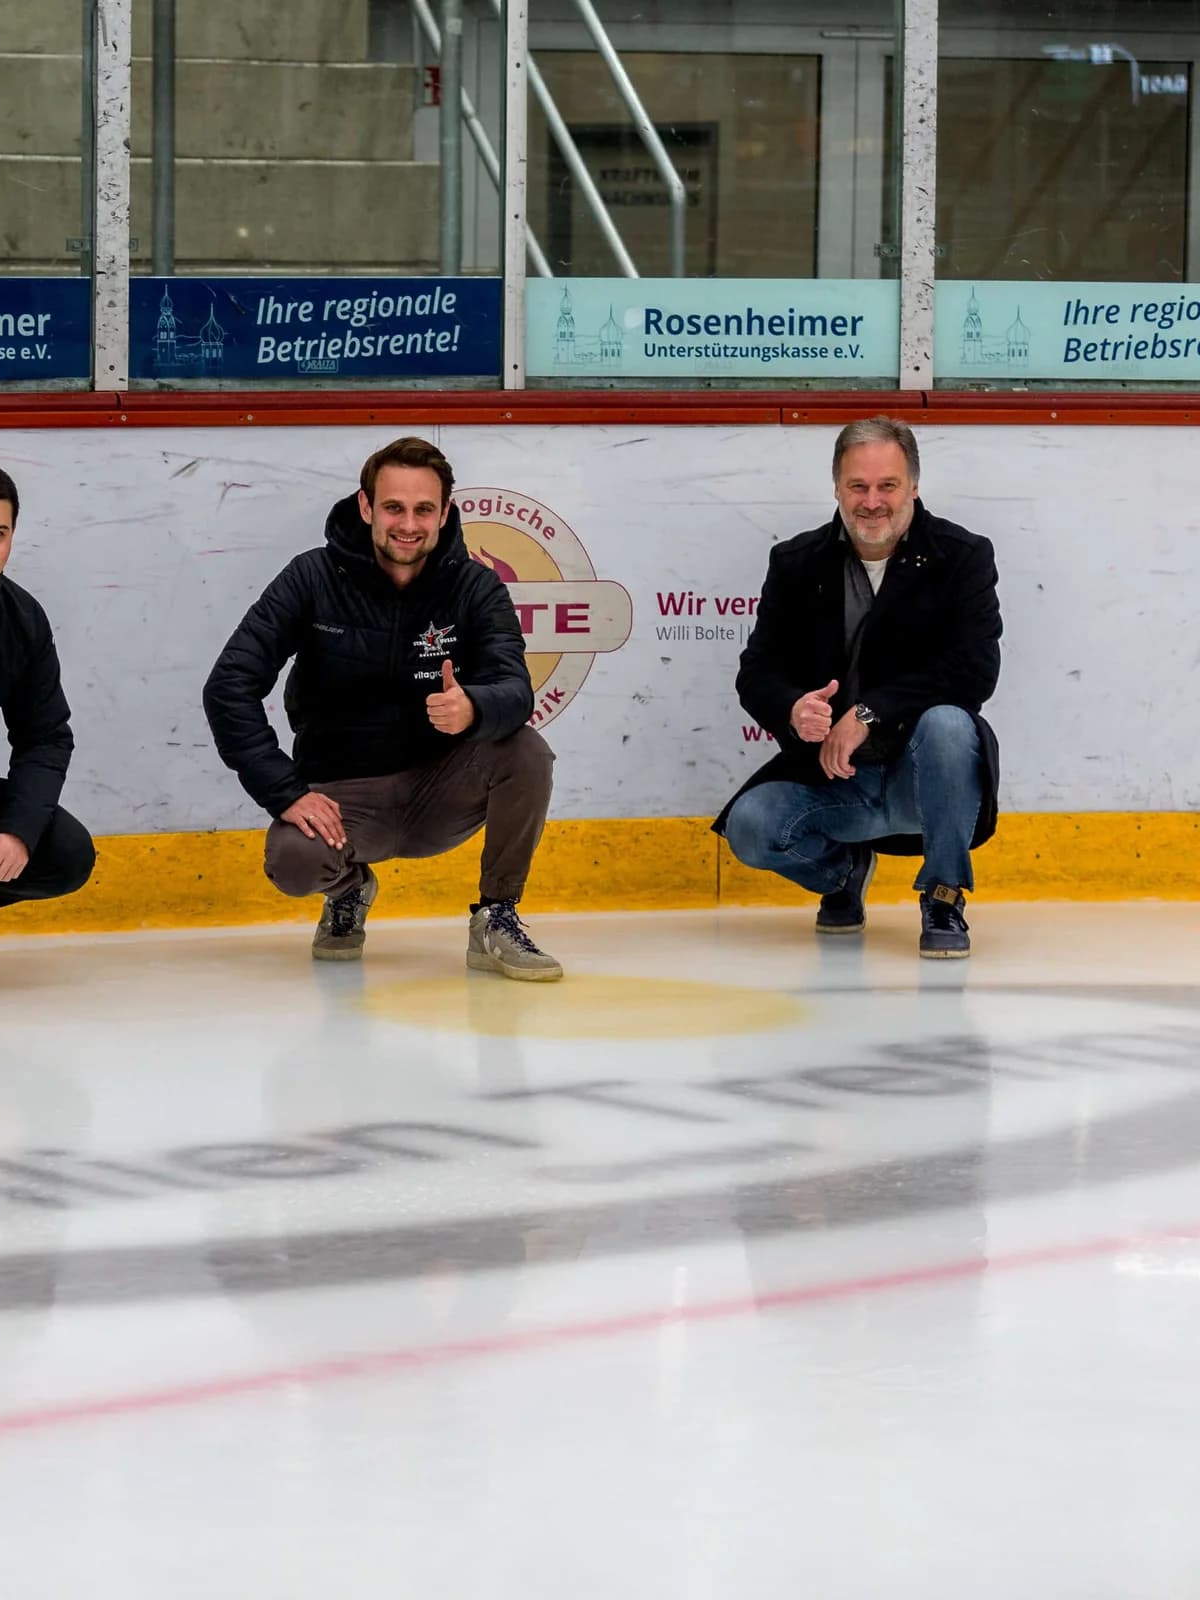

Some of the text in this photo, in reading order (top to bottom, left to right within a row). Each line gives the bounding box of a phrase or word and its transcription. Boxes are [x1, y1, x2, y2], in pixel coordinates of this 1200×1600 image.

[256, 286, 457, 328] Ihre regionale
[1063, 295, 1200, 329] Ihre regio
[644, 308, 864, 337] Rosenheimer
[20, 344, 52, 361] e.V.
[257, 325, 461, 364] Betriebsrente!
[644, 342, 865, 363] Unterstützungskasse e.V.
[450, 495, 556, 541] ogische
[656, 591, 762, 616] Wir ver
[656, 625, 690, 640] Willi
[695, 625, 735, 641] Bolte
